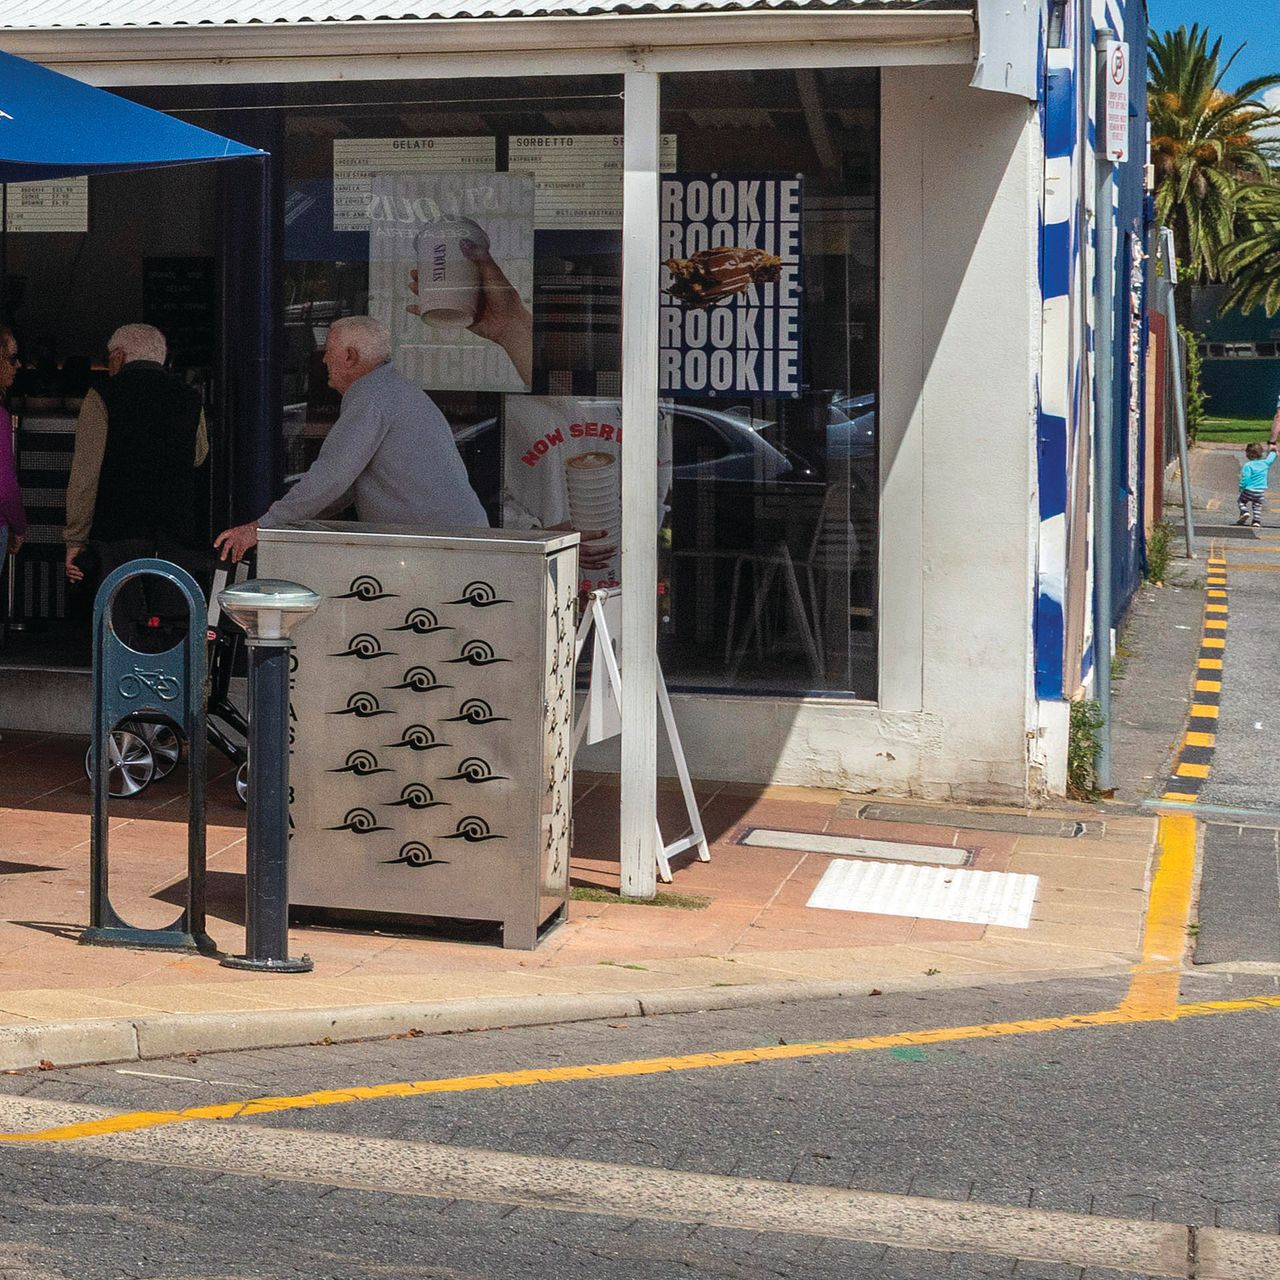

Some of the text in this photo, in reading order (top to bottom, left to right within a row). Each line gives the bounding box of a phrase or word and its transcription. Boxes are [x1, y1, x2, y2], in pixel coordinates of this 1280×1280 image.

[392, 139, 435, 150] GELATO
[516, 137, 574, 147] SORBETTO
[661, 180, 800, 221] ROOKIE
[660, 222, 799, 263] ROOKIE
[659, 307, 799, 349] ROOKIE
[659, 349, 798, 391] ROOKIE
[521, 427, 565, 468] NOW
